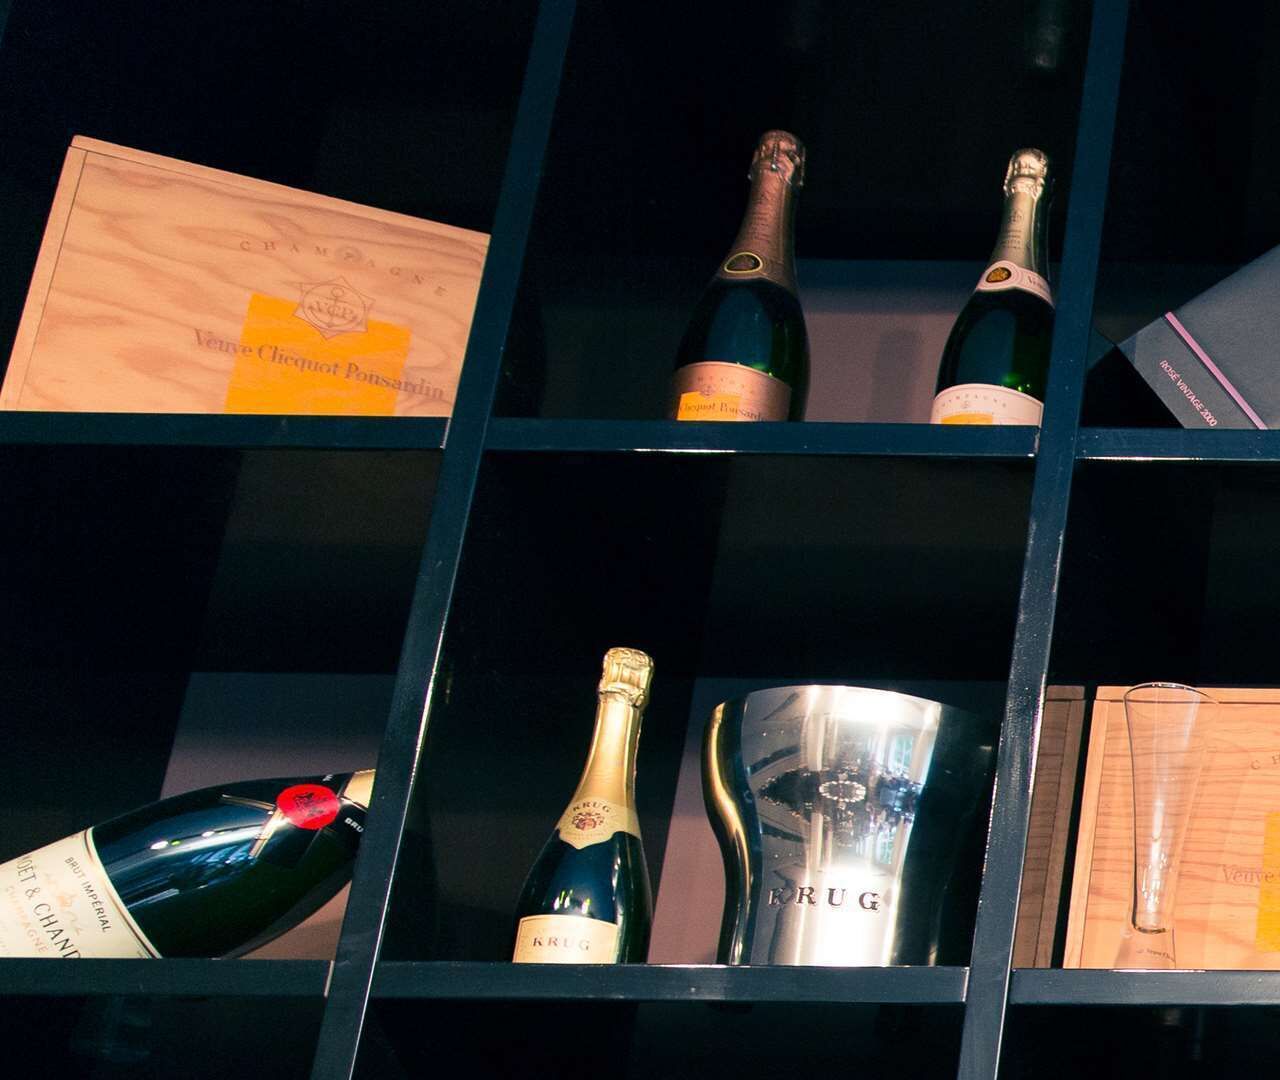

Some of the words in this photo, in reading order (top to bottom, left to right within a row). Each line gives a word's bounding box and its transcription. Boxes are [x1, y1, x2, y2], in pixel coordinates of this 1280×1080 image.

[239, 240, 447, 297] CHAMPAGNE
[194, 328, 252, 357] Veuve
[256, 344, 341, 377] Clicquot
[345, 362, 446, 401] Ponsardin
[1158, 358, 1181, 382] ROSÉ
[1174, 376, 1206, 411] VINTAGE
[1199, 405, 1219, 428] 2000
[572, 801, 611, 814] KRUG
[1220, 863, 1275, 884] Veuve
[65, 857, 86, 880] BRUT
[81, 880, 112, 933] IMPÉRIAL
[768, 886, 881, 912] KRUG
[532, 937, 591, 952] KRUG
